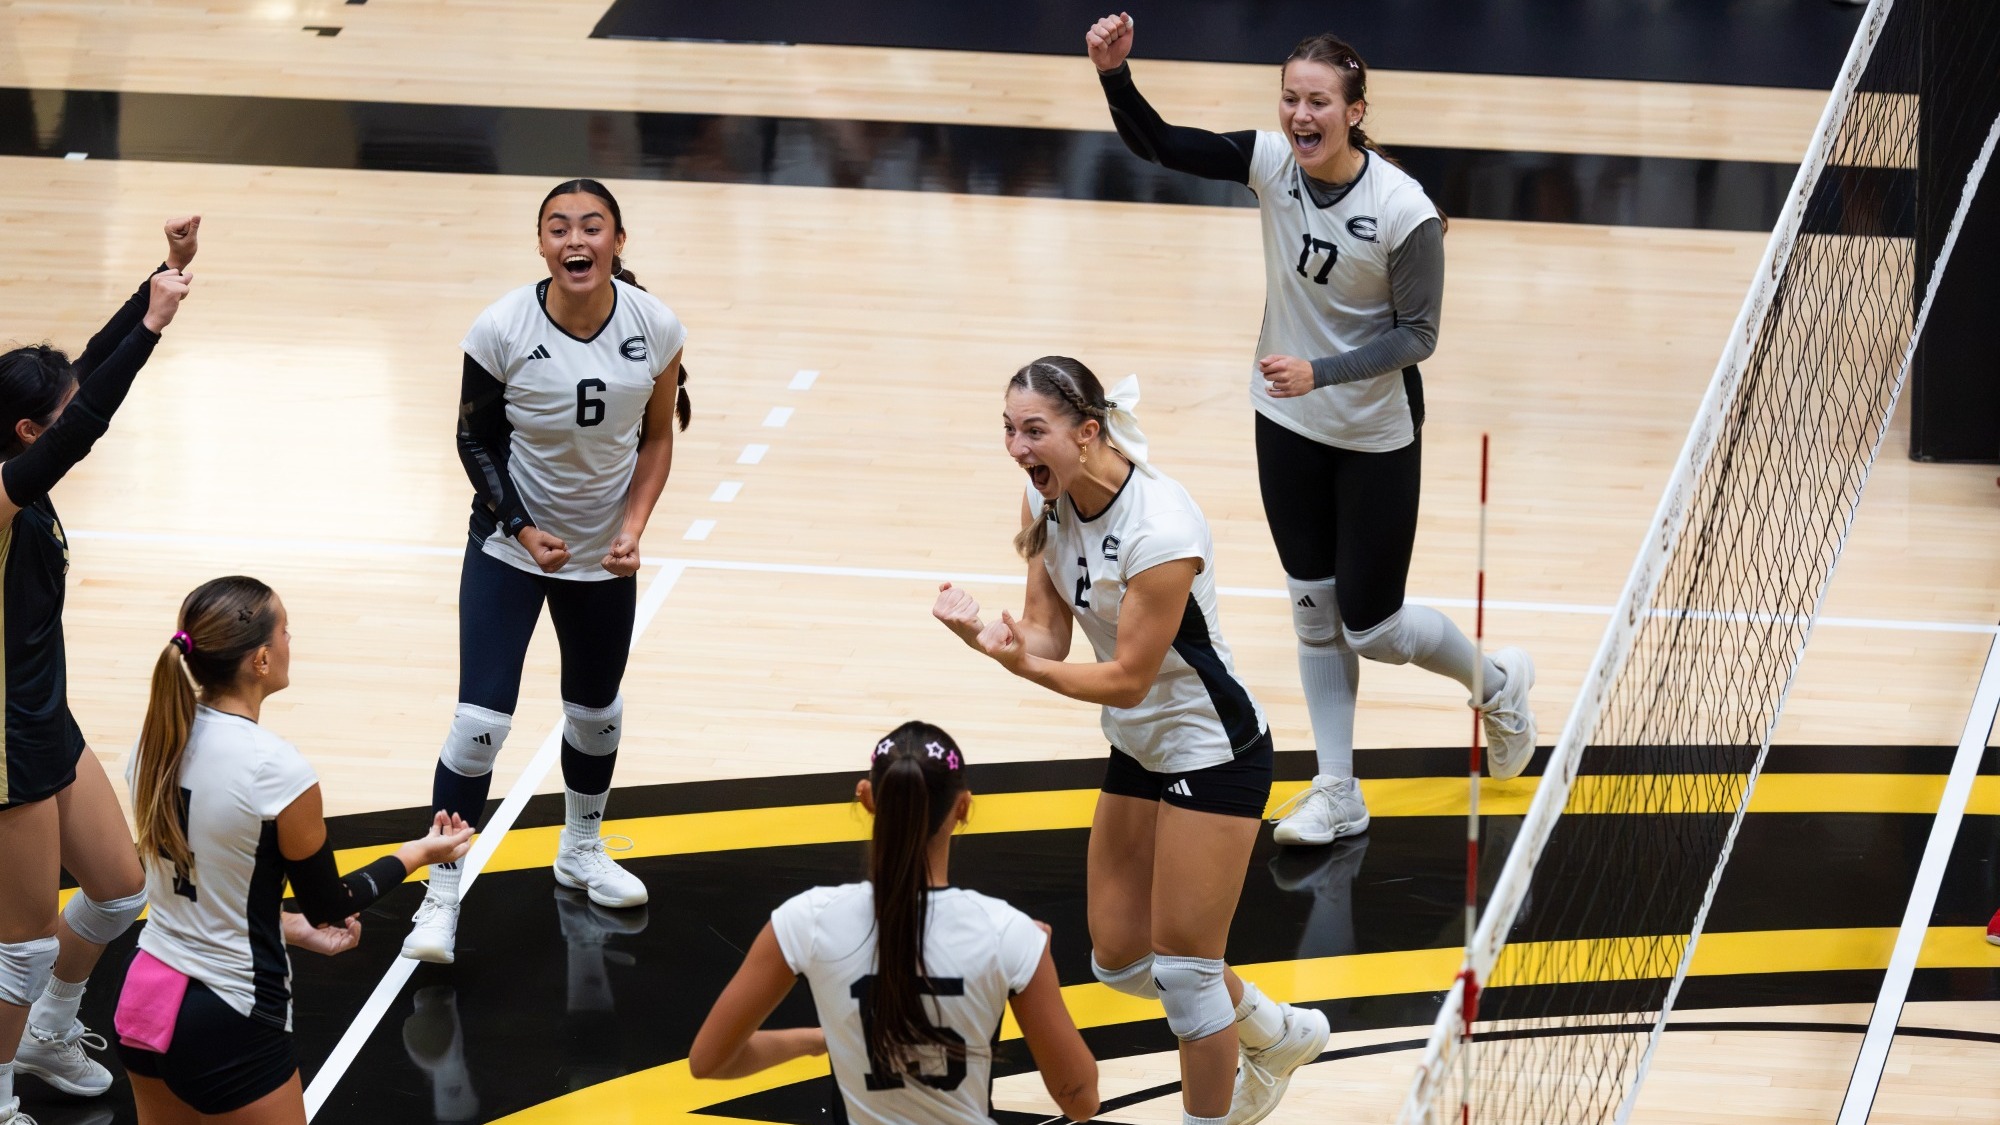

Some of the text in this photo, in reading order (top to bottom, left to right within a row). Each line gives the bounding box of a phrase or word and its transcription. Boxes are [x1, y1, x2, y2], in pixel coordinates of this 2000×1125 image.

[1297, 233, 1338, 285] 17
[576, 377, 607, 427] 6
[1075, 556, 1092, 608] 2
[850, 974, 968, 1091] 15
